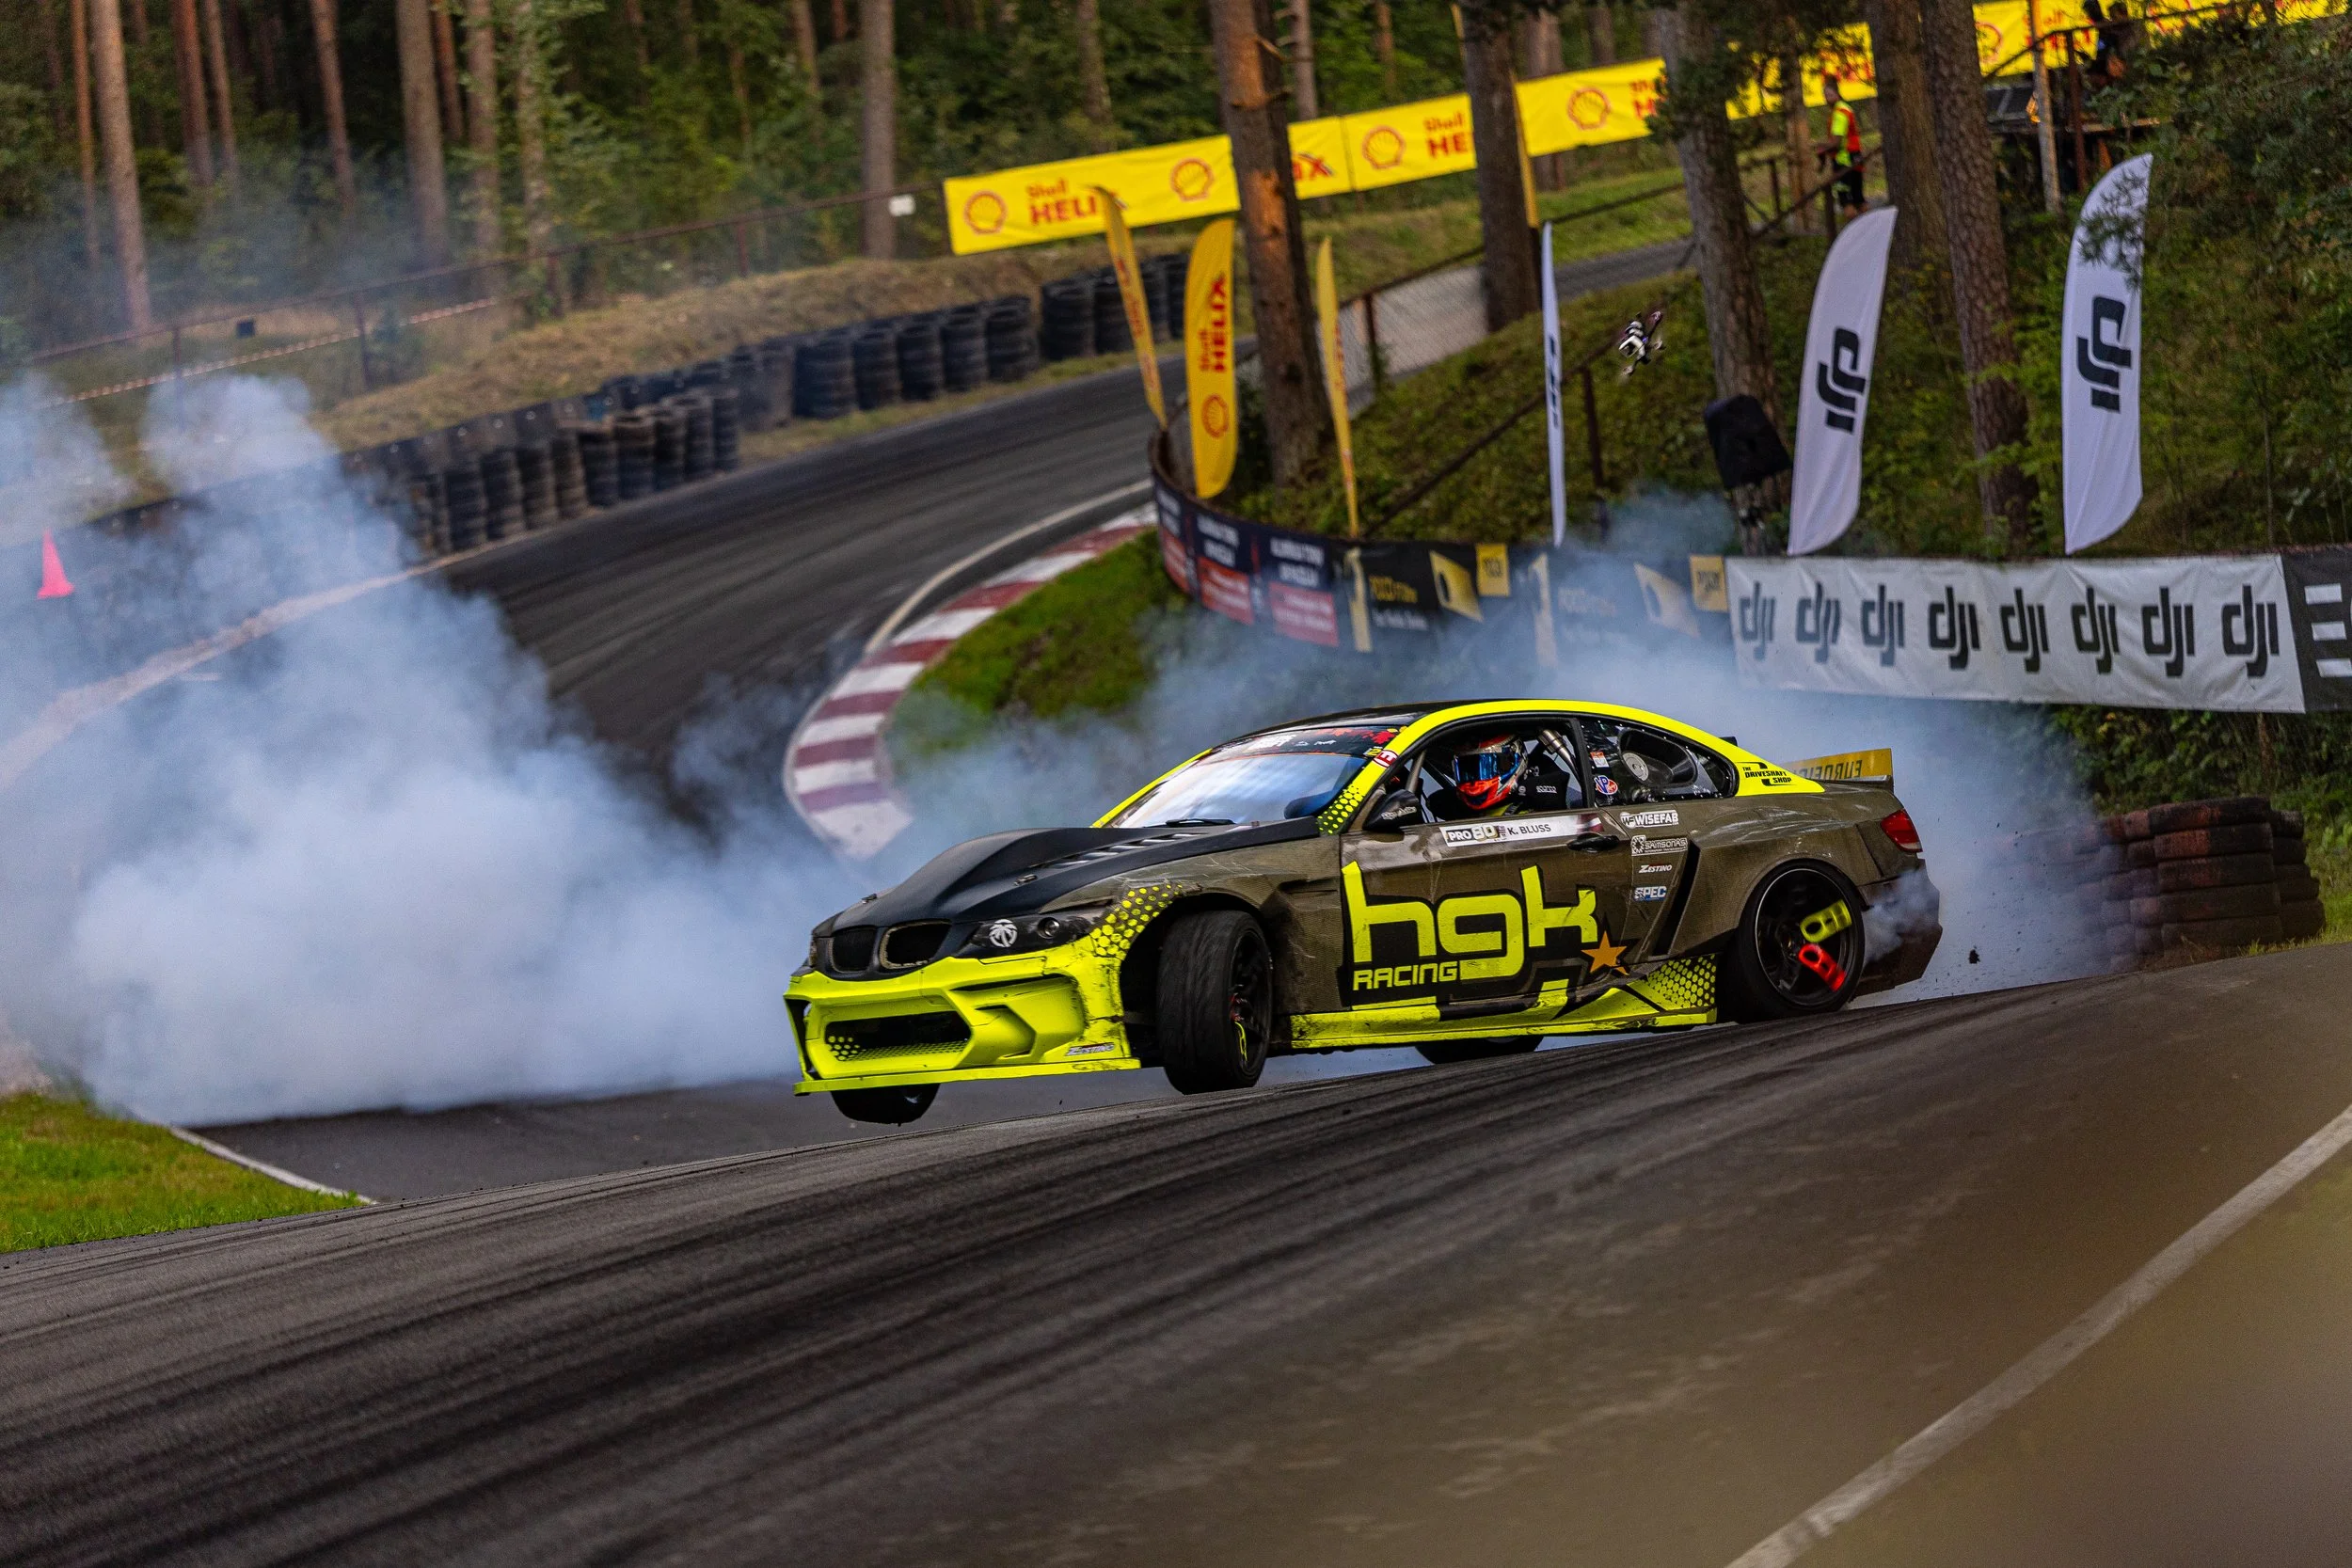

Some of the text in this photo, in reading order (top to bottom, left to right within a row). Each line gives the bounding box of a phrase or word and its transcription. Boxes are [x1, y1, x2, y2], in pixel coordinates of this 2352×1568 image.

[1209, 271, 1227, 372] HELIX
[1740, 581, 2280, 677] dji dji dji dji dji dji dji dji
[1744, 770, 1787, 779] DRIVESHAFT
[1635, 812, 1679, 826] WISEFAB
[1448, 829, 1472, 841] PRO
[1507, 827, 1518, 836] K.
[1520, 824, 1552, 835] BLUSS
[1634, 886, 1667, 899] SPEC
[1342, 861, 1598, 980] hgk
[1353, 961, 1457, 991] RACING
